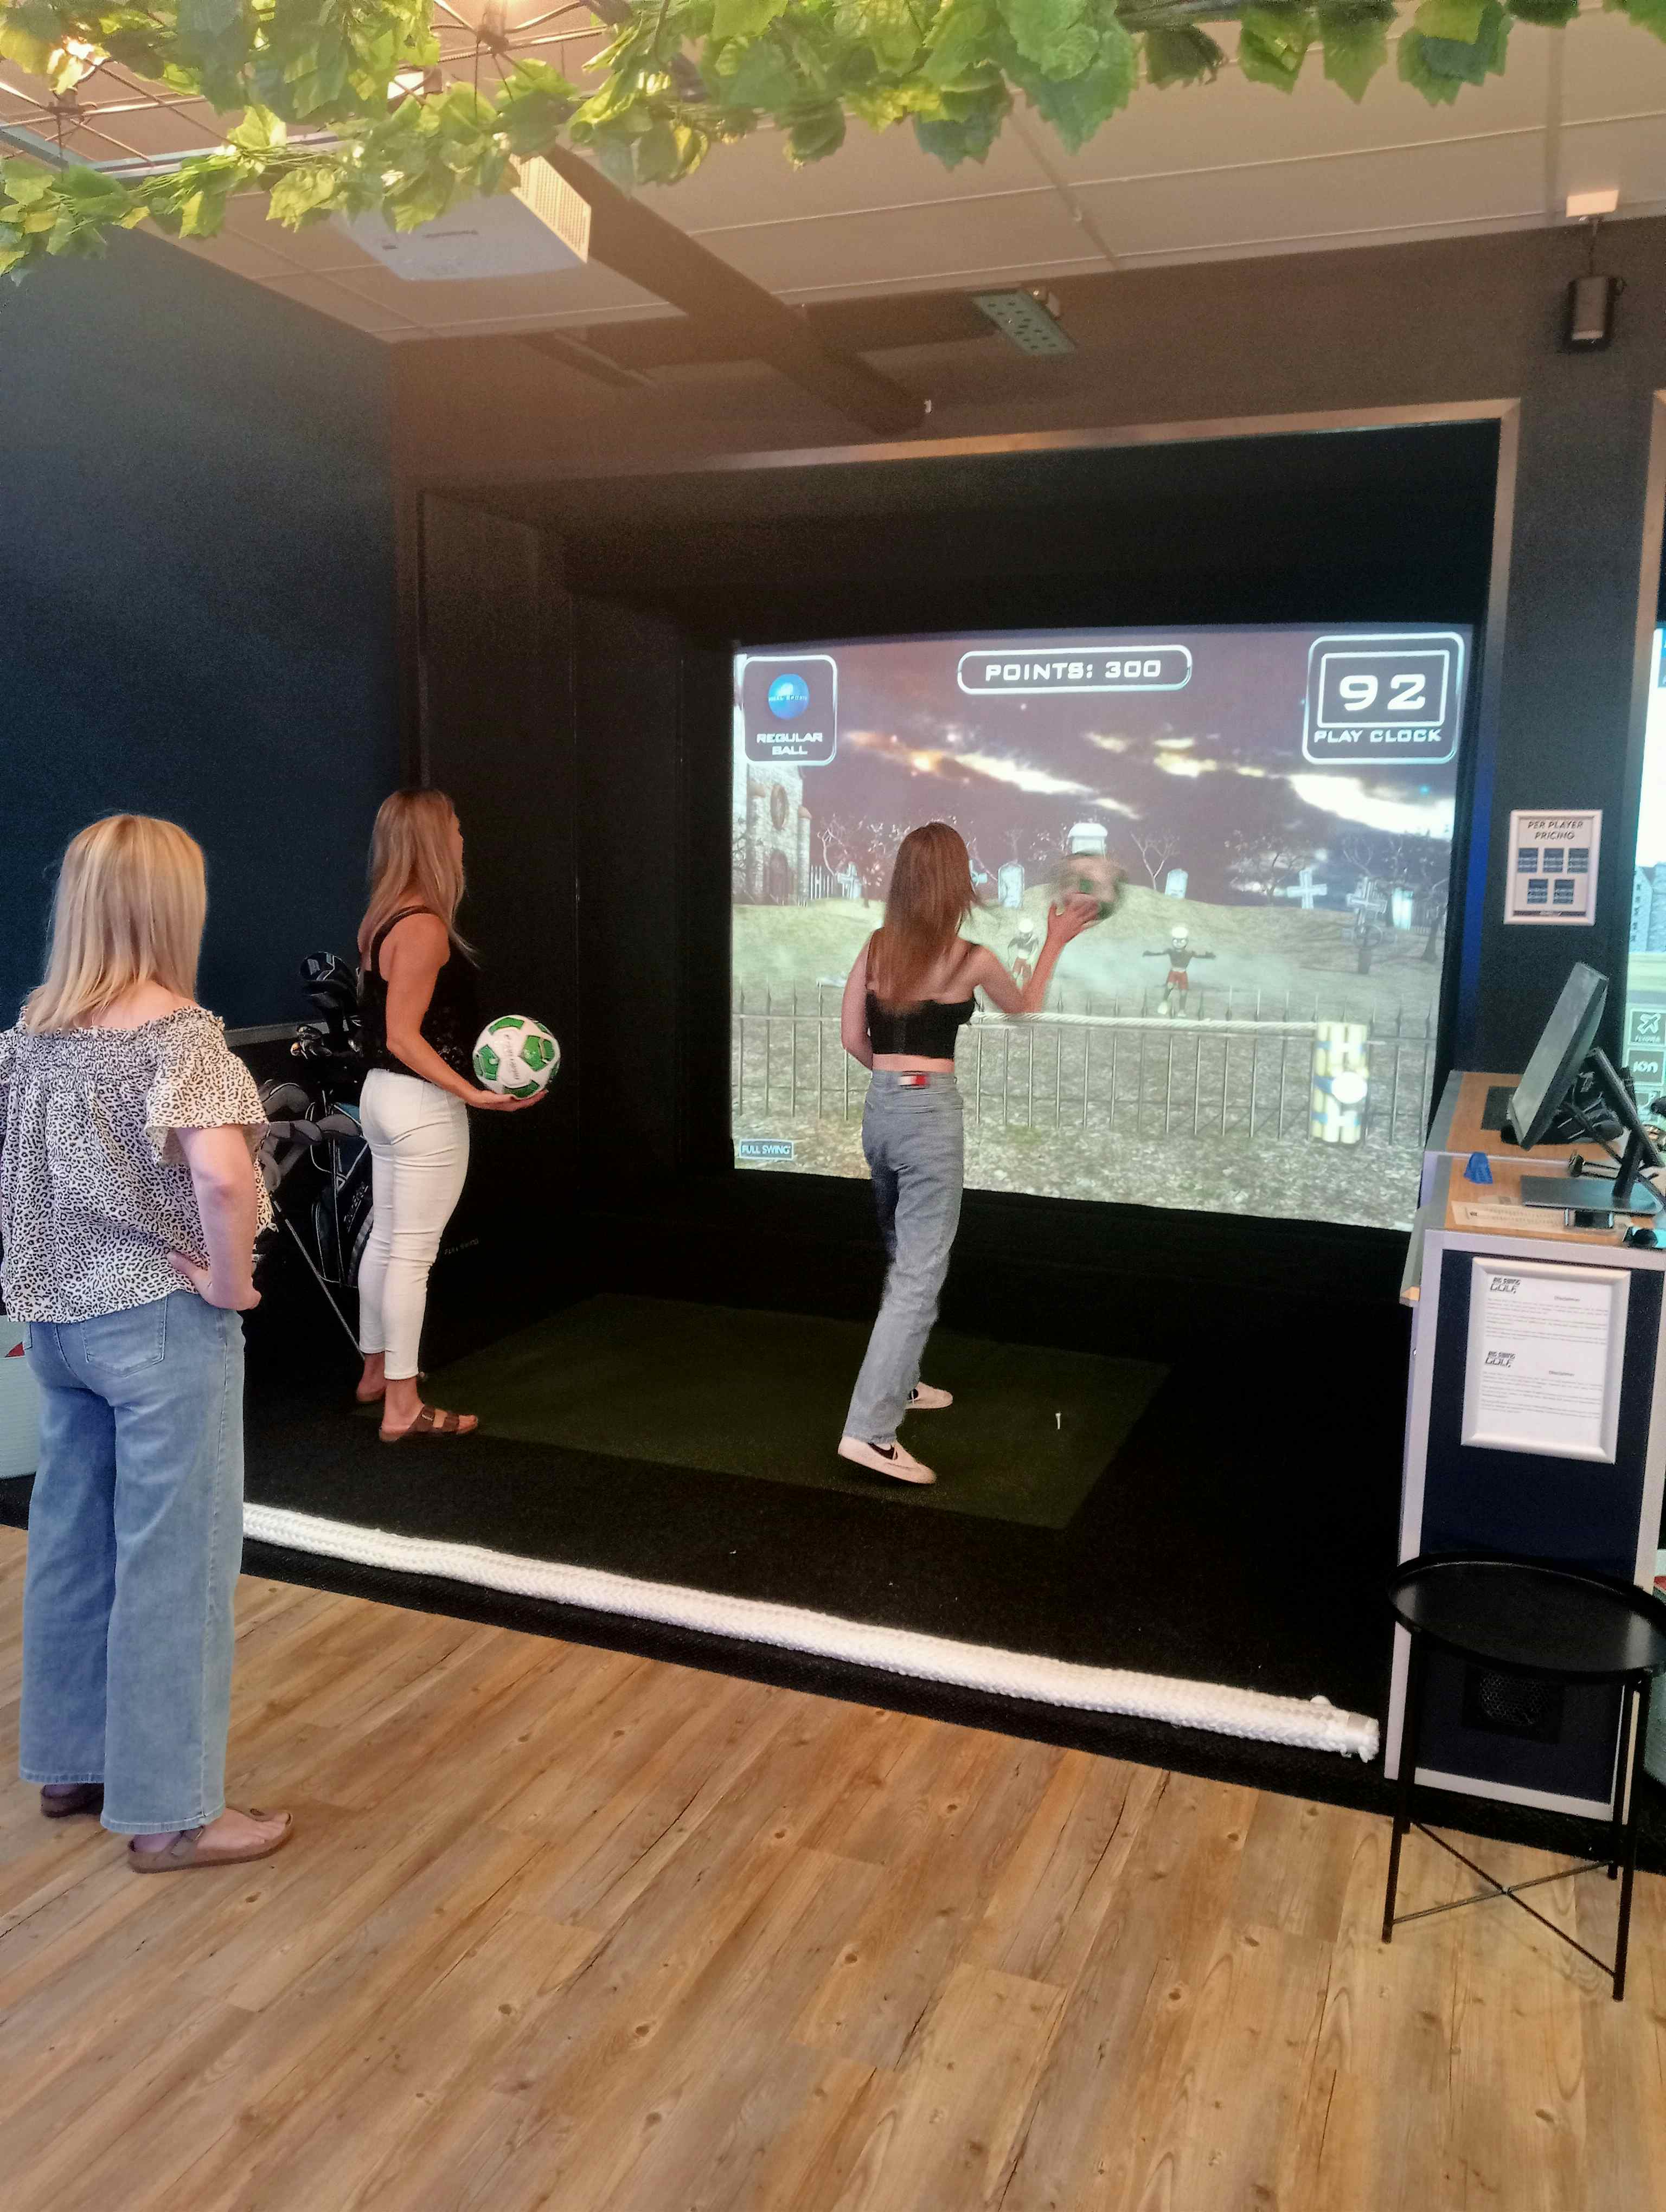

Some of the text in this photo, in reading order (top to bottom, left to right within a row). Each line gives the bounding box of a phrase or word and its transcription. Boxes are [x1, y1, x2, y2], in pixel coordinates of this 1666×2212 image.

[985, 660, 1161, 681] POINTS: 300
[1340, 673, 1426, 711] 92
[757, 732, 823, 743] REGULAR
[1314, 729, 1441, 743] PLAY CLOCK
[772, 745, 808, 755] BALL
[1527, 821, 1584, 829] PER PLAYER
[1534, 831, 1575, 840] PRICING
[741, 1144, 791, 1155] FULL SWING
